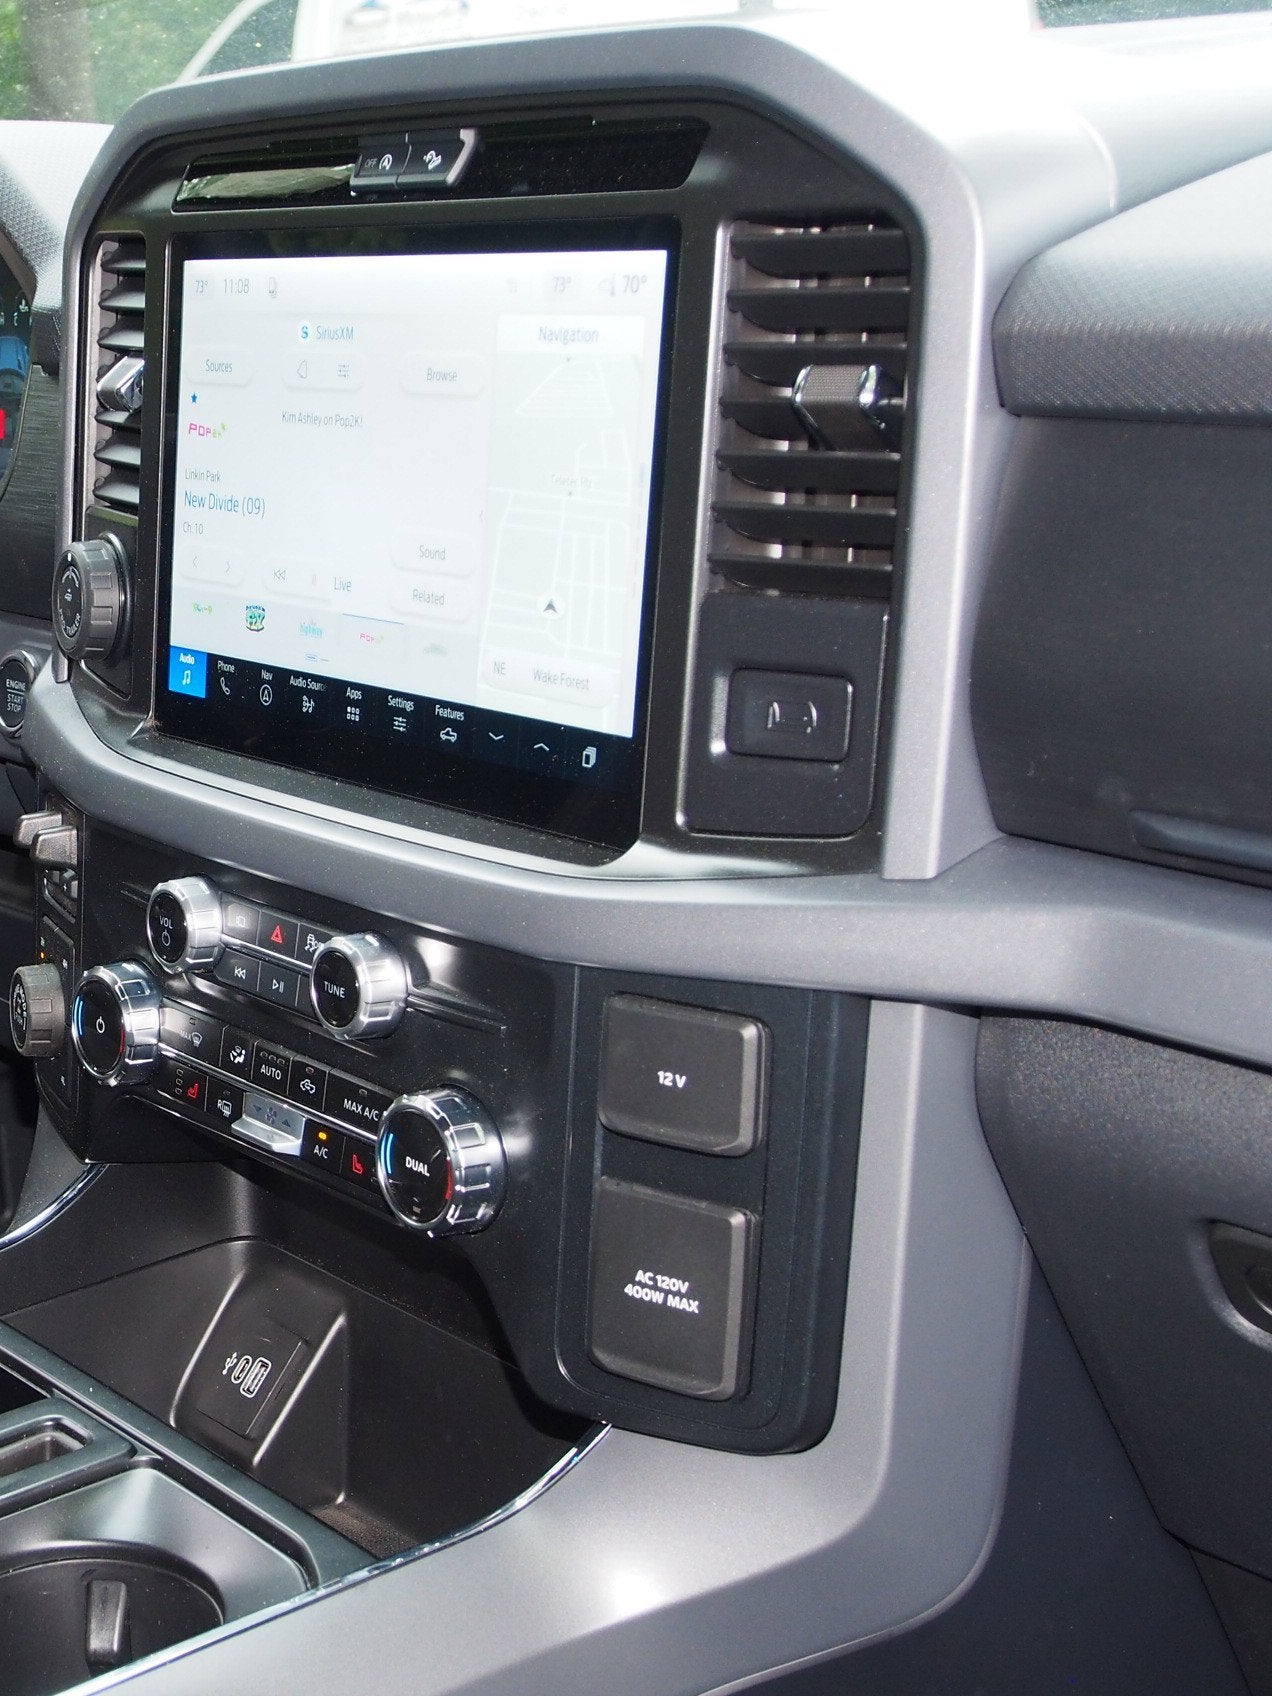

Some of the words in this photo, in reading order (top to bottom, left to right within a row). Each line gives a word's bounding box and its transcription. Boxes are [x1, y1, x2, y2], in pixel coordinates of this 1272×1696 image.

[223, 278, 250, 294] 11:08
[315, 325, 355, 341] SiriusXM
[537, 326, 599, 346] Navigation
[205, 359, 233, 373] Sources
[426, 367, 458, 382] Browse
[281, 411, 297, 424] Kim
[298, 412, 322, 427] Ashley
[184, 468, 205, 481] Linkin
[206, 471, 221, 483] Park
[184, 490, 207, 508] New
[208, 493, 239, 513] Divide
[241, 497, 266, 519] (09)
[419, 545, 446, 561] Sound
[334, 576, 352, 592] Live
[412, 588, 445, 606] Related
[179, 653, 195, 665] Audio
[218, 660, 235, 673] Phone
[261, 669, 273, 681] Nav
[493, 661, 506, 675] NE
[6, 678, 26, 691] ENGINE
[289, 675, 307, 688] Audio
[533, 667, 558, 684] Wake
[560, 671, 590, 690] Forest
[7, 693, 24, 704] START
[346, 687, 362, 700] Apps
[7, 703, 22, 712] STOP
[388, 695, 414, 711] Settings
[435, 705, 464, 720] Features
[159, 916, 173, 930] VOL
[324, 981, 346, 998] TUNE
[260, 1064, 282, 1080] AUTO
[658, 1070, 675, 1086] 12
[675, 1074, 686, 1088] V
[343, 1098, 363, 1114] MAX
[364, 1106, 379, 1122] A/C
[314, 1145, 328, 1159] A/C
[405, 1156, 430, 1176] DUAL
[635, 1270, 655, 1285] AC
[656, 1273, 689, 1293] 120V
[624, 1284, 665, 1304] 400W
[667, 1294, 699, 1313] MAX
